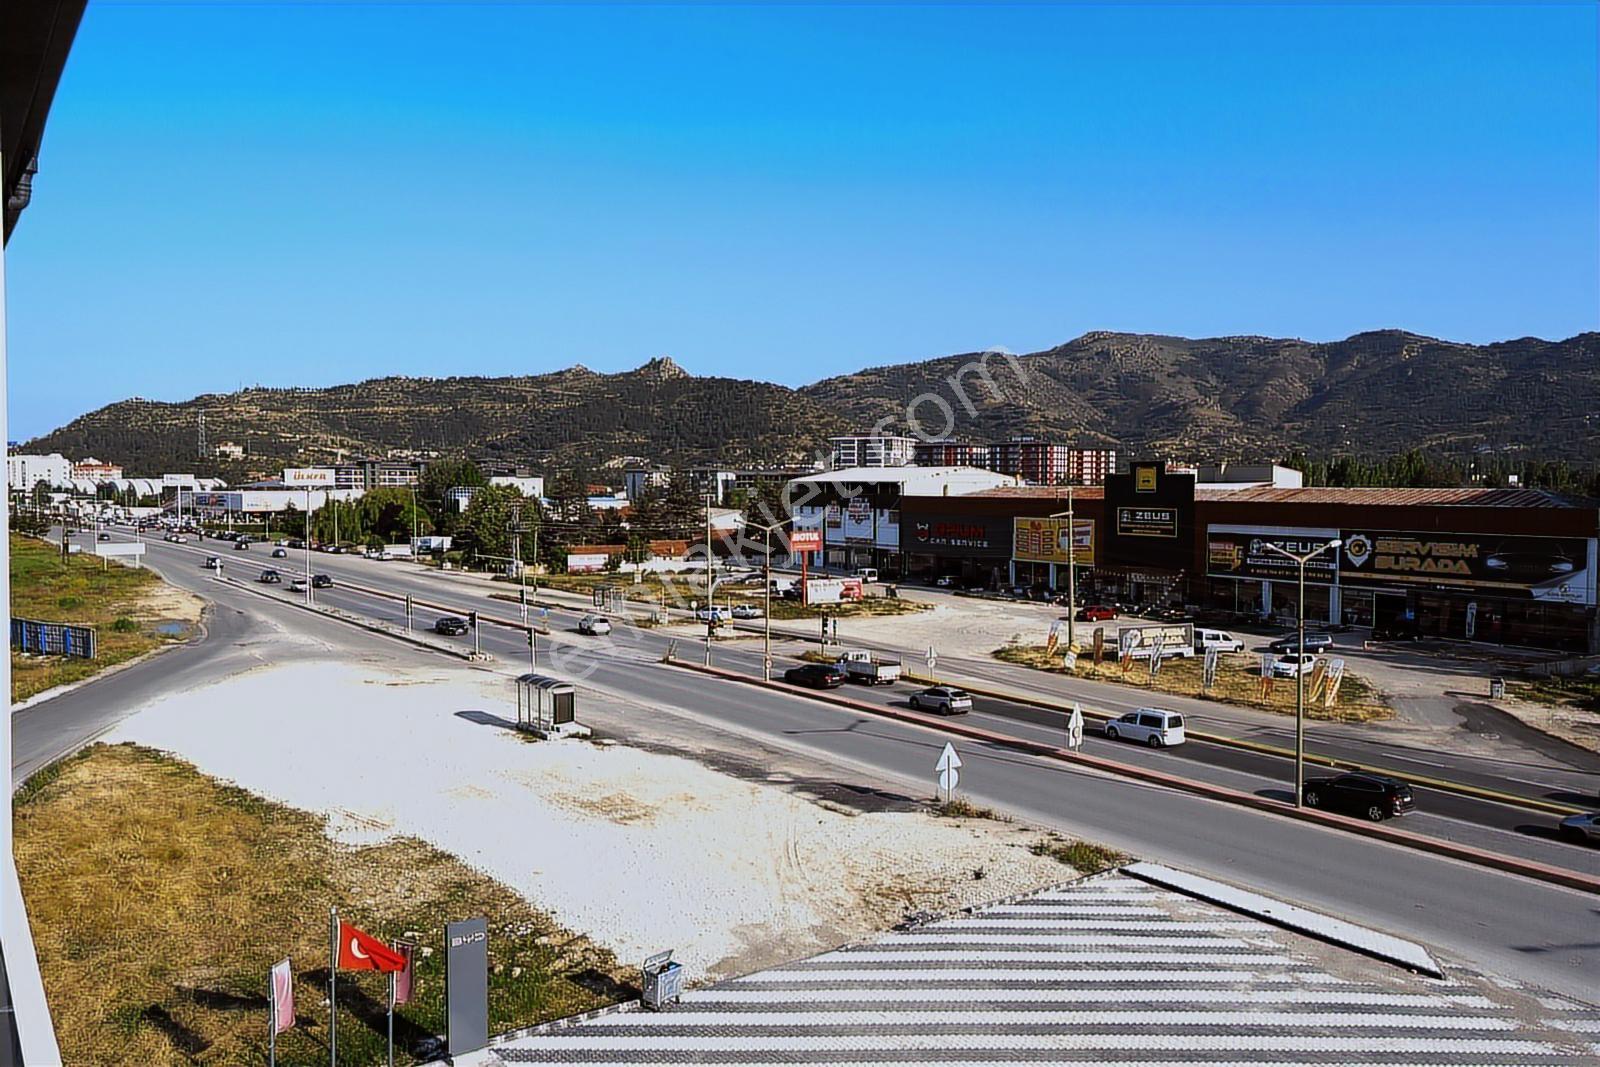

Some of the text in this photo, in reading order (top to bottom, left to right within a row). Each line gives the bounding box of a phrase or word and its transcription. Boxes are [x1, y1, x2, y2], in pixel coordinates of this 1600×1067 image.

[791, 531, 820, 542] MOTUL
[1272, 541, 1325, 554] ZEUS
[1374, 555, 1473, 575] BURADA
[451, 931, 486, 947] BYD
